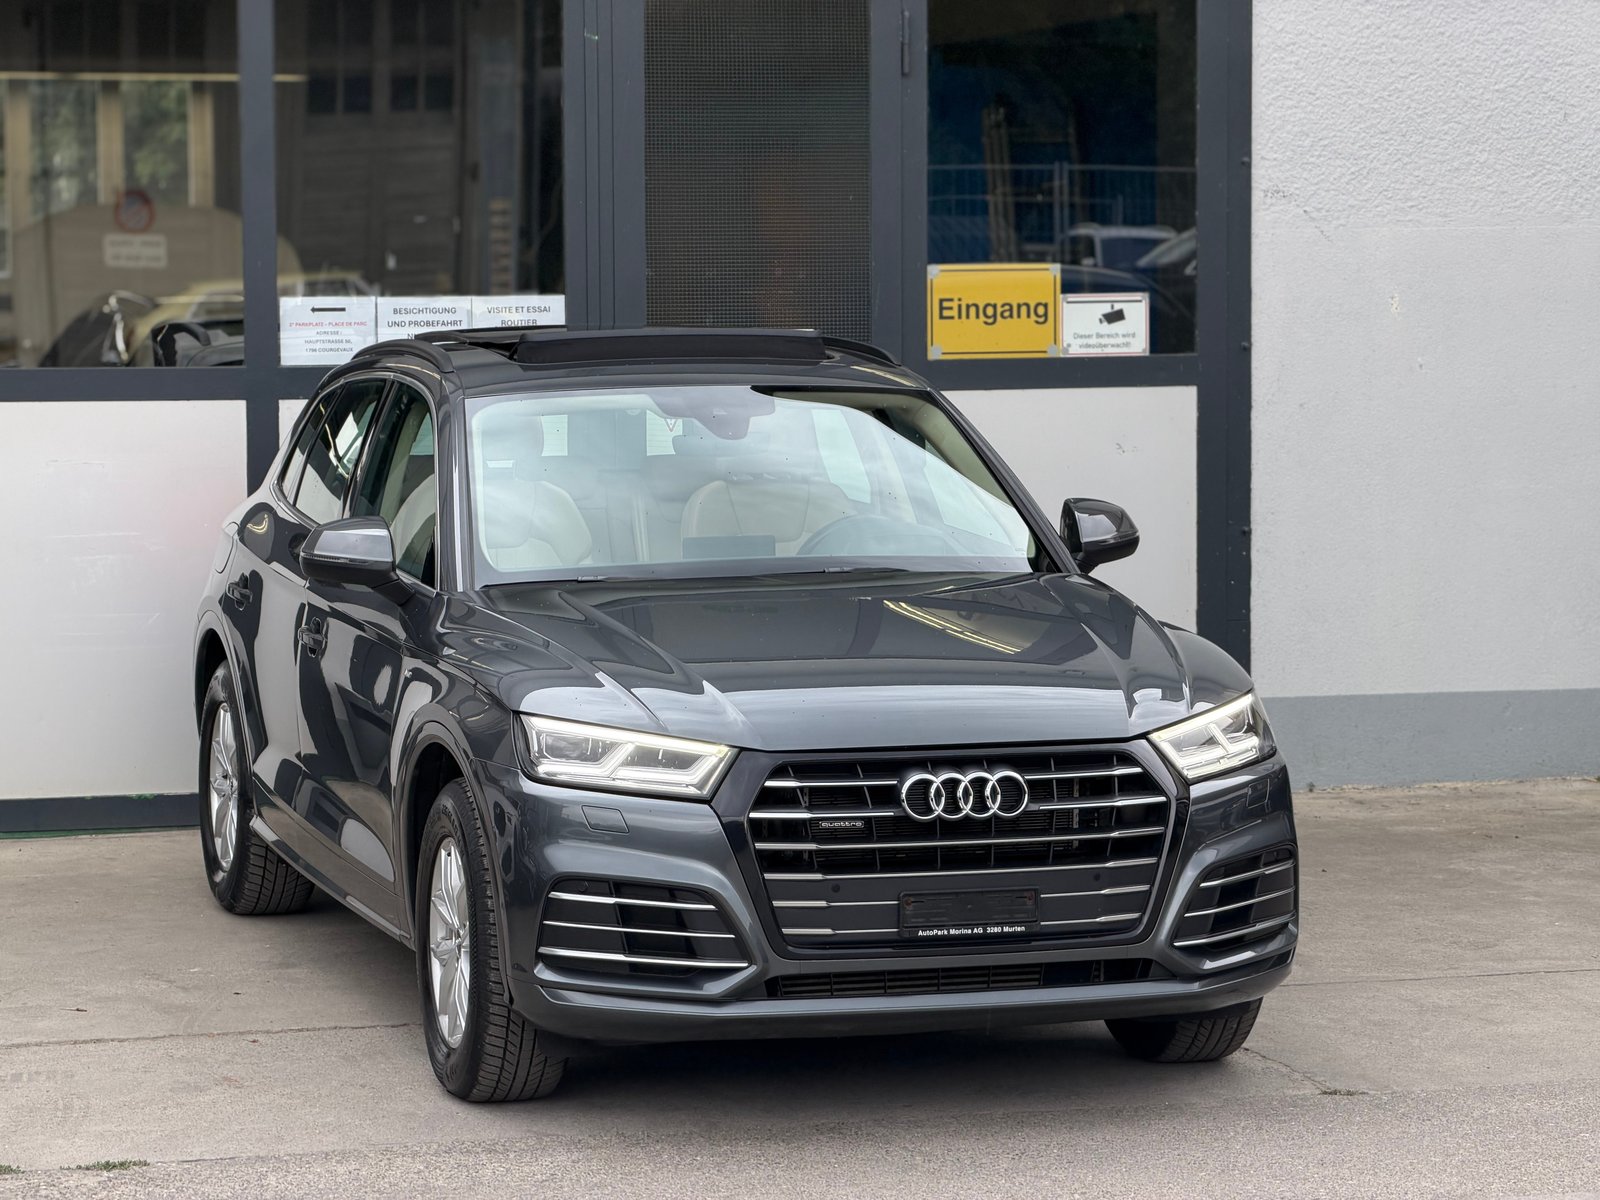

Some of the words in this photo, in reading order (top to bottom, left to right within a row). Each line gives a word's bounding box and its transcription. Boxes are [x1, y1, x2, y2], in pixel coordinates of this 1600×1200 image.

[393, 307, 457, 315] BESICHTIGUNG
[487, 306, 513, 314] VISITE
[526, 305, 551, 313] ESSAI
[938, 297, 1049, 326] Eingang
[387, 320, 407, 328] UND
[408, 319, 463, 327] PROBEFAHRT
[501, 319, 538, 327] ROUTIER
[1073, 332, 1093, 340] Dieser
[917, 928, 948, 936] AutoPark
[949, 927, 972, 935] Morina
[1003, 925, 1026, 933] Murten
